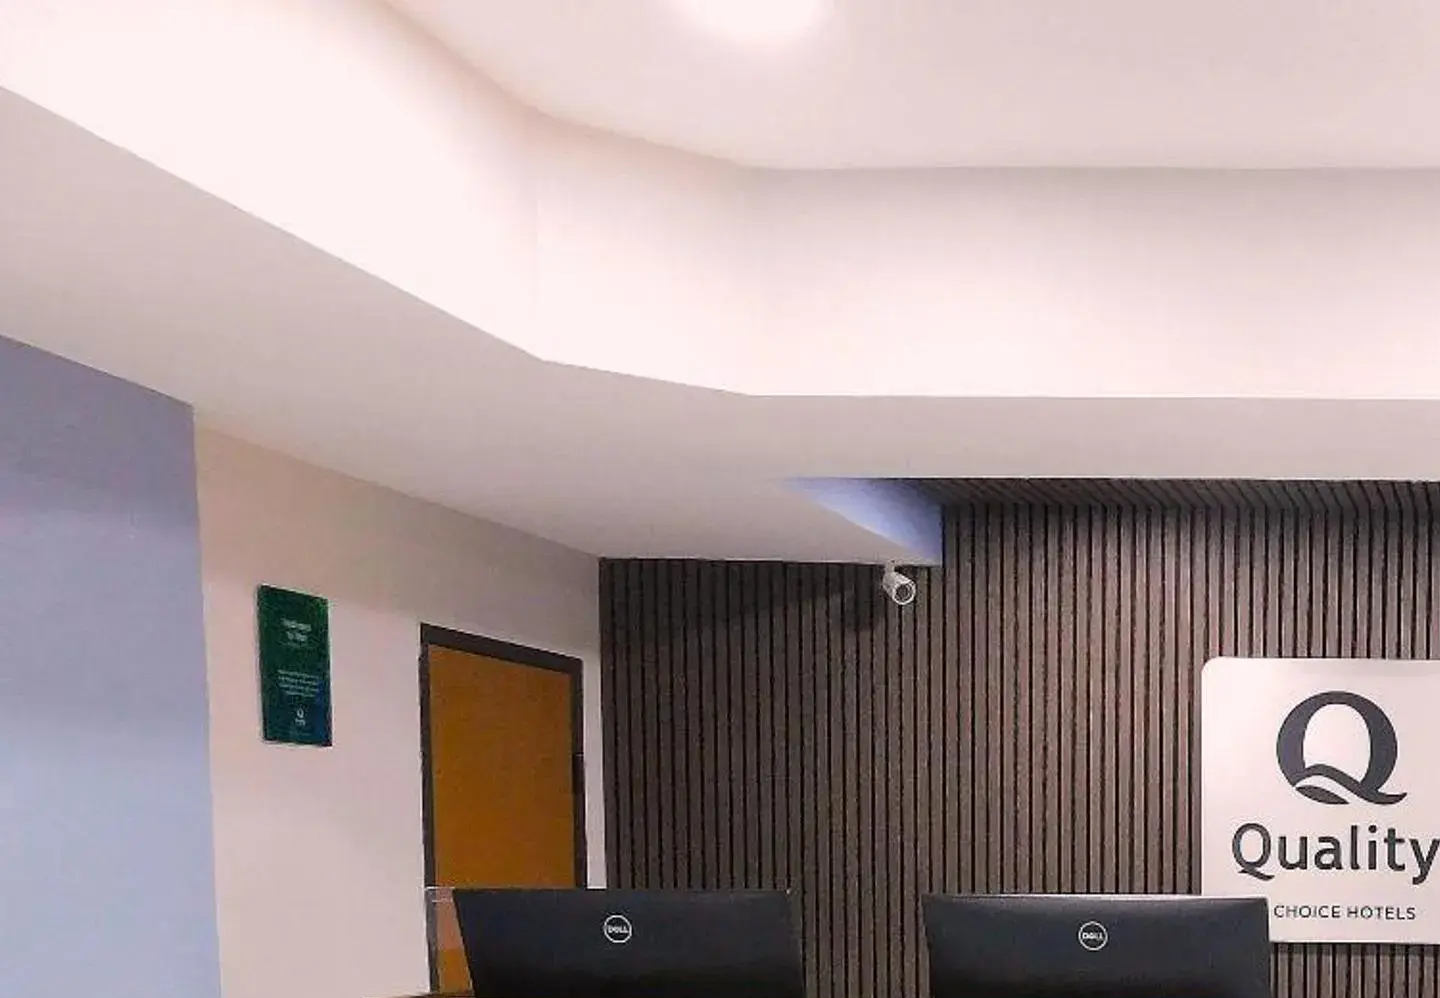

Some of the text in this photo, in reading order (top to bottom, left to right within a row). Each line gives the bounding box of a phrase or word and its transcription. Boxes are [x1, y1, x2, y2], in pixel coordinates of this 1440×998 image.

[1276, 690, 1408, 805] Q
[1273, 904, 1416, 920] CHOICE HOTELS
